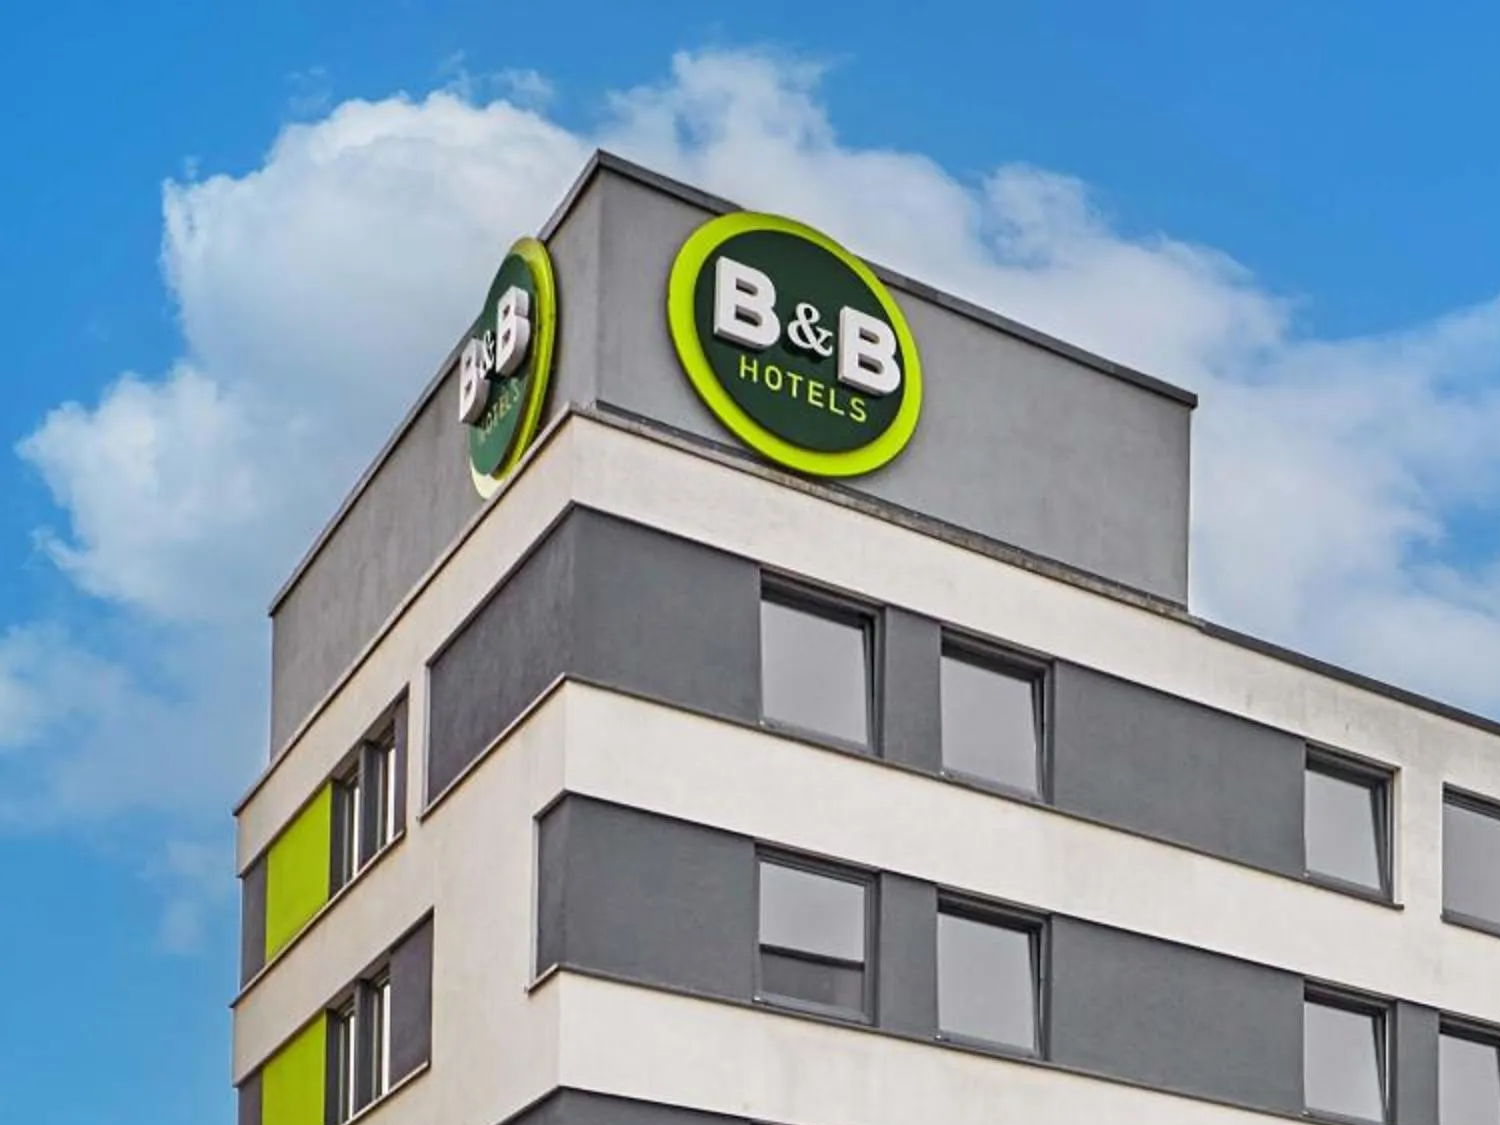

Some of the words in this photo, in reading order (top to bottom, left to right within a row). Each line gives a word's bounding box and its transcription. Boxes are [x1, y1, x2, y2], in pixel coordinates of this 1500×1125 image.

[459, 285, 531, 425] B&B
[714, 256, 901, 396] B&B
[739, 354, 867, 422] HOTELS
